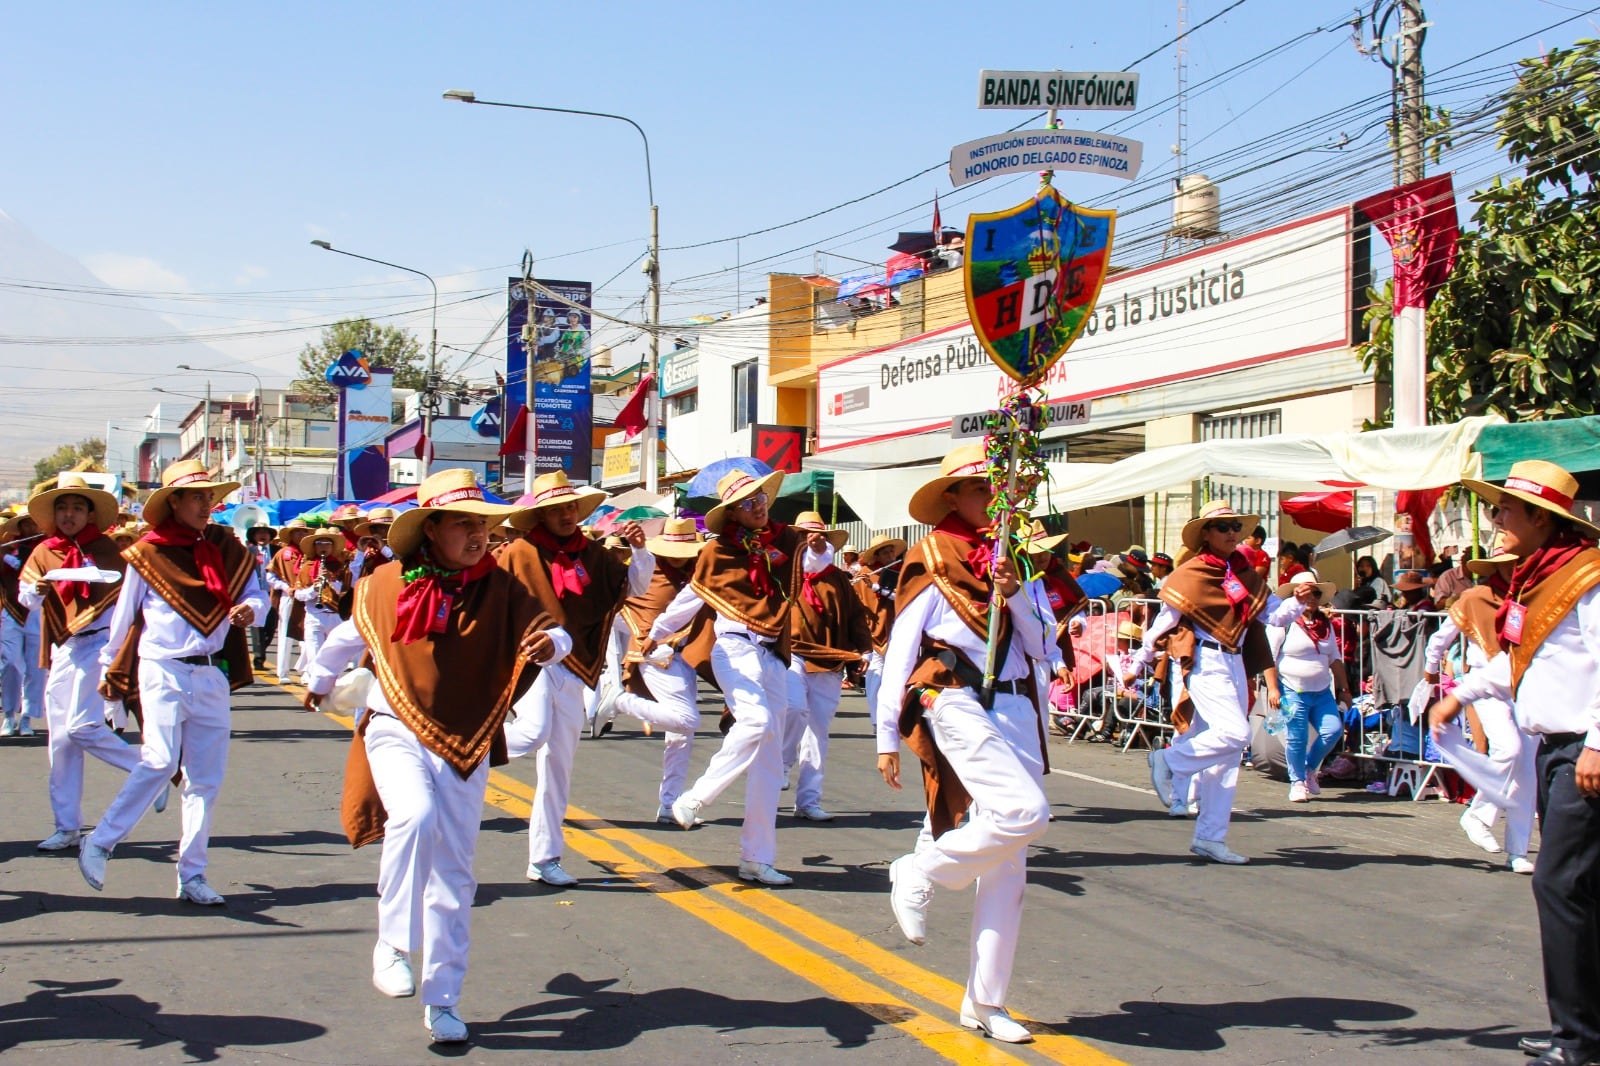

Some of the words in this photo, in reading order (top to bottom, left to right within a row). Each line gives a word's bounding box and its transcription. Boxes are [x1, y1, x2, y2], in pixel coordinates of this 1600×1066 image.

[983, 78, 1041, 106] BANDA
[1046, 75, 1136, 106] SINFÓNICA
[969, 136, 1025, 160] INSTITUCIÓN
[1026, 134, 1073, 146] EDUCATIVA
[1073, 136, 1128, 154] EMBLEMÁTICA
[965, 154, 1020, 179] HONORIO
[1022, 151, 1077, 166] DELGADO
[1078, 152, 1129, 172] ESPINOZA
[984, 228, 995, 252] I
[994, 290, 1020, 330] H
[1030, 278, 1053, 316] D
[1065, 264, 1086, 301] E
[881, 353, 941, 390] Defensa
[946, 335, 987, 373] Públi
[1104, 304, 1116, 332] a
[1123, 292, 1142, 327] la
[1148, 262, 1244, 322] Justicia
[329, 365, 369, 378] AVA
[475, 412, 502, 425] AV
[1019, 403, 1086, 425] AQUIPA
[537, 438, 573, 446] EGURIDAD
